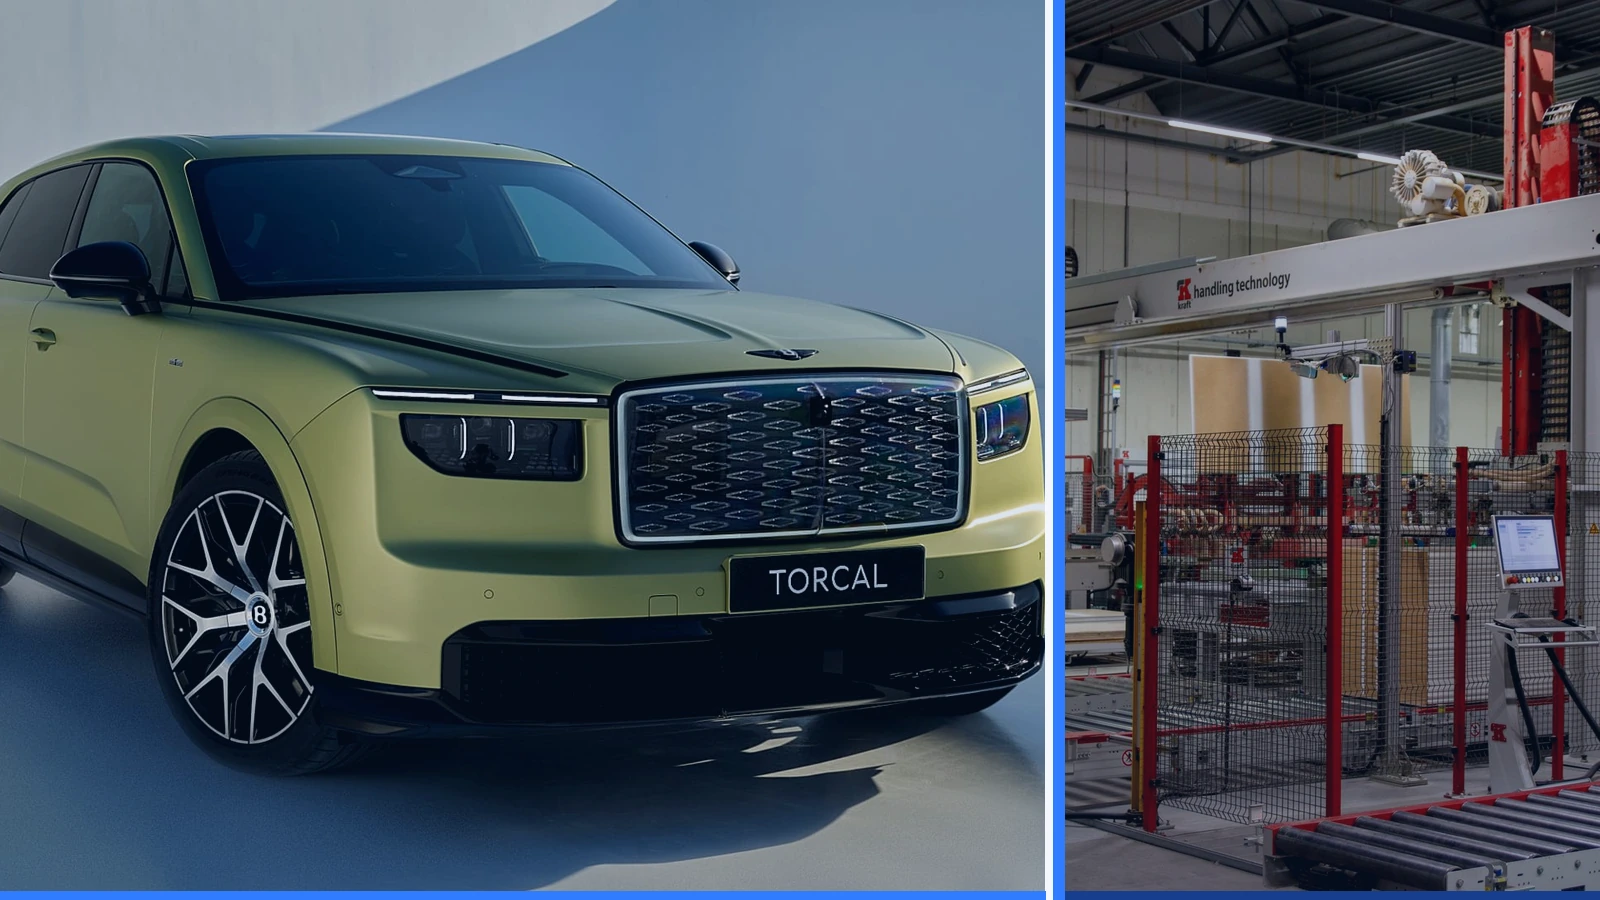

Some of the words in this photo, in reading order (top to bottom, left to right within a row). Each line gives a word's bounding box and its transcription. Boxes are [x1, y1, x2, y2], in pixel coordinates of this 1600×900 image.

[1194, 281, 1234, 298] handling
[1236, 272, 1291, 290] technology
[1178, 301, 1192, 310] kraft
[769, 563, 888, 595] TORCAL
